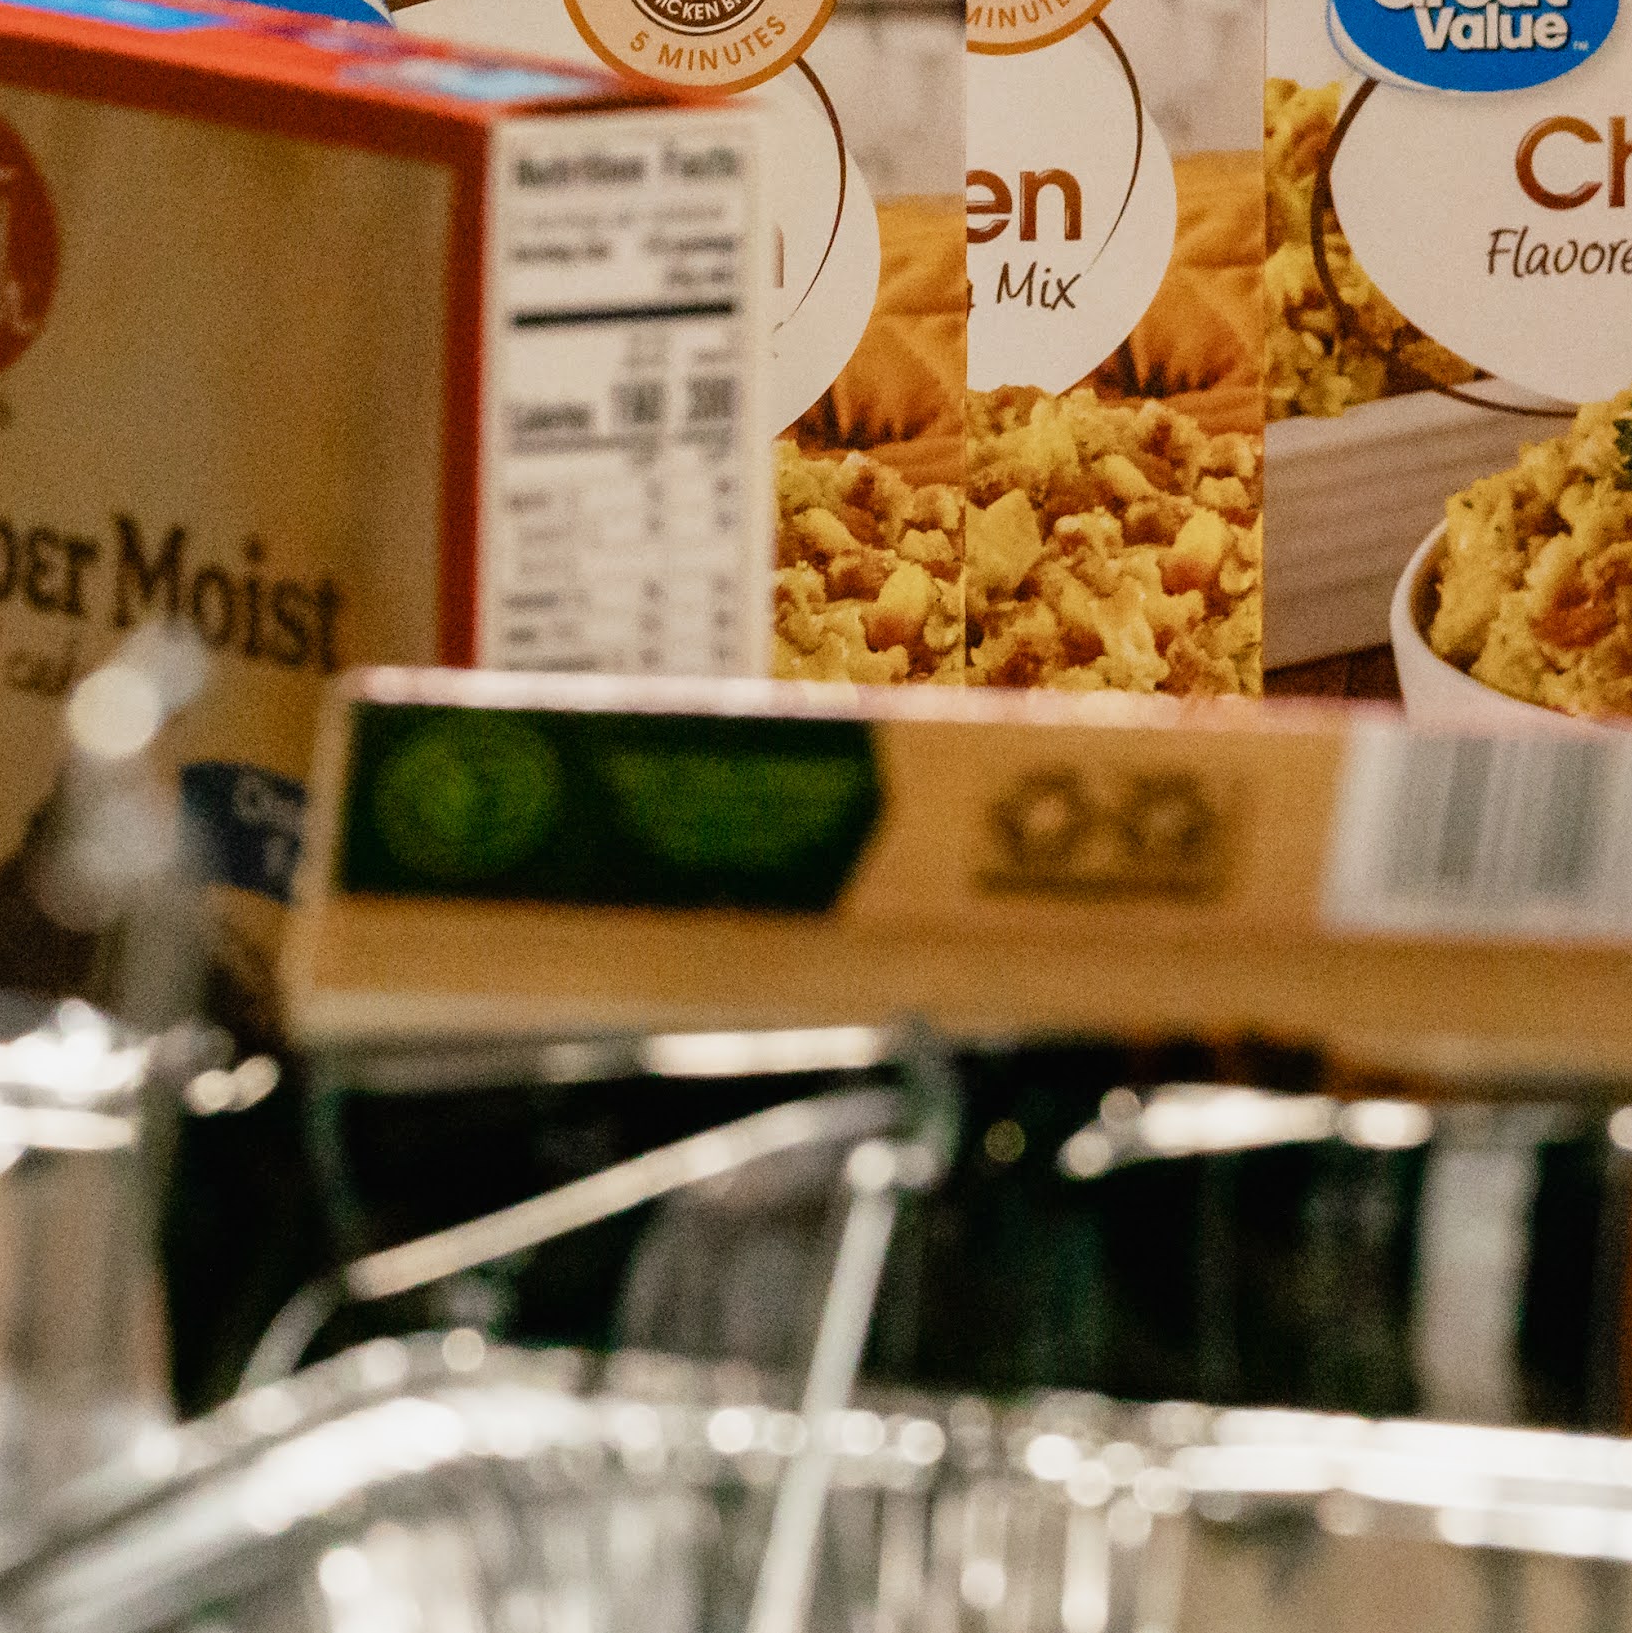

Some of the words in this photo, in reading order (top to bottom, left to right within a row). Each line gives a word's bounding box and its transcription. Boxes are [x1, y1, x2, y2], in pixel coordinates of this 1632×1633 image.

[630, 30, 650, 52] 5
[657, 15, 786, 71] MINUTES
[1414, 1, 1569, 51] Value
[996, 260, 1082, 311] Mix
